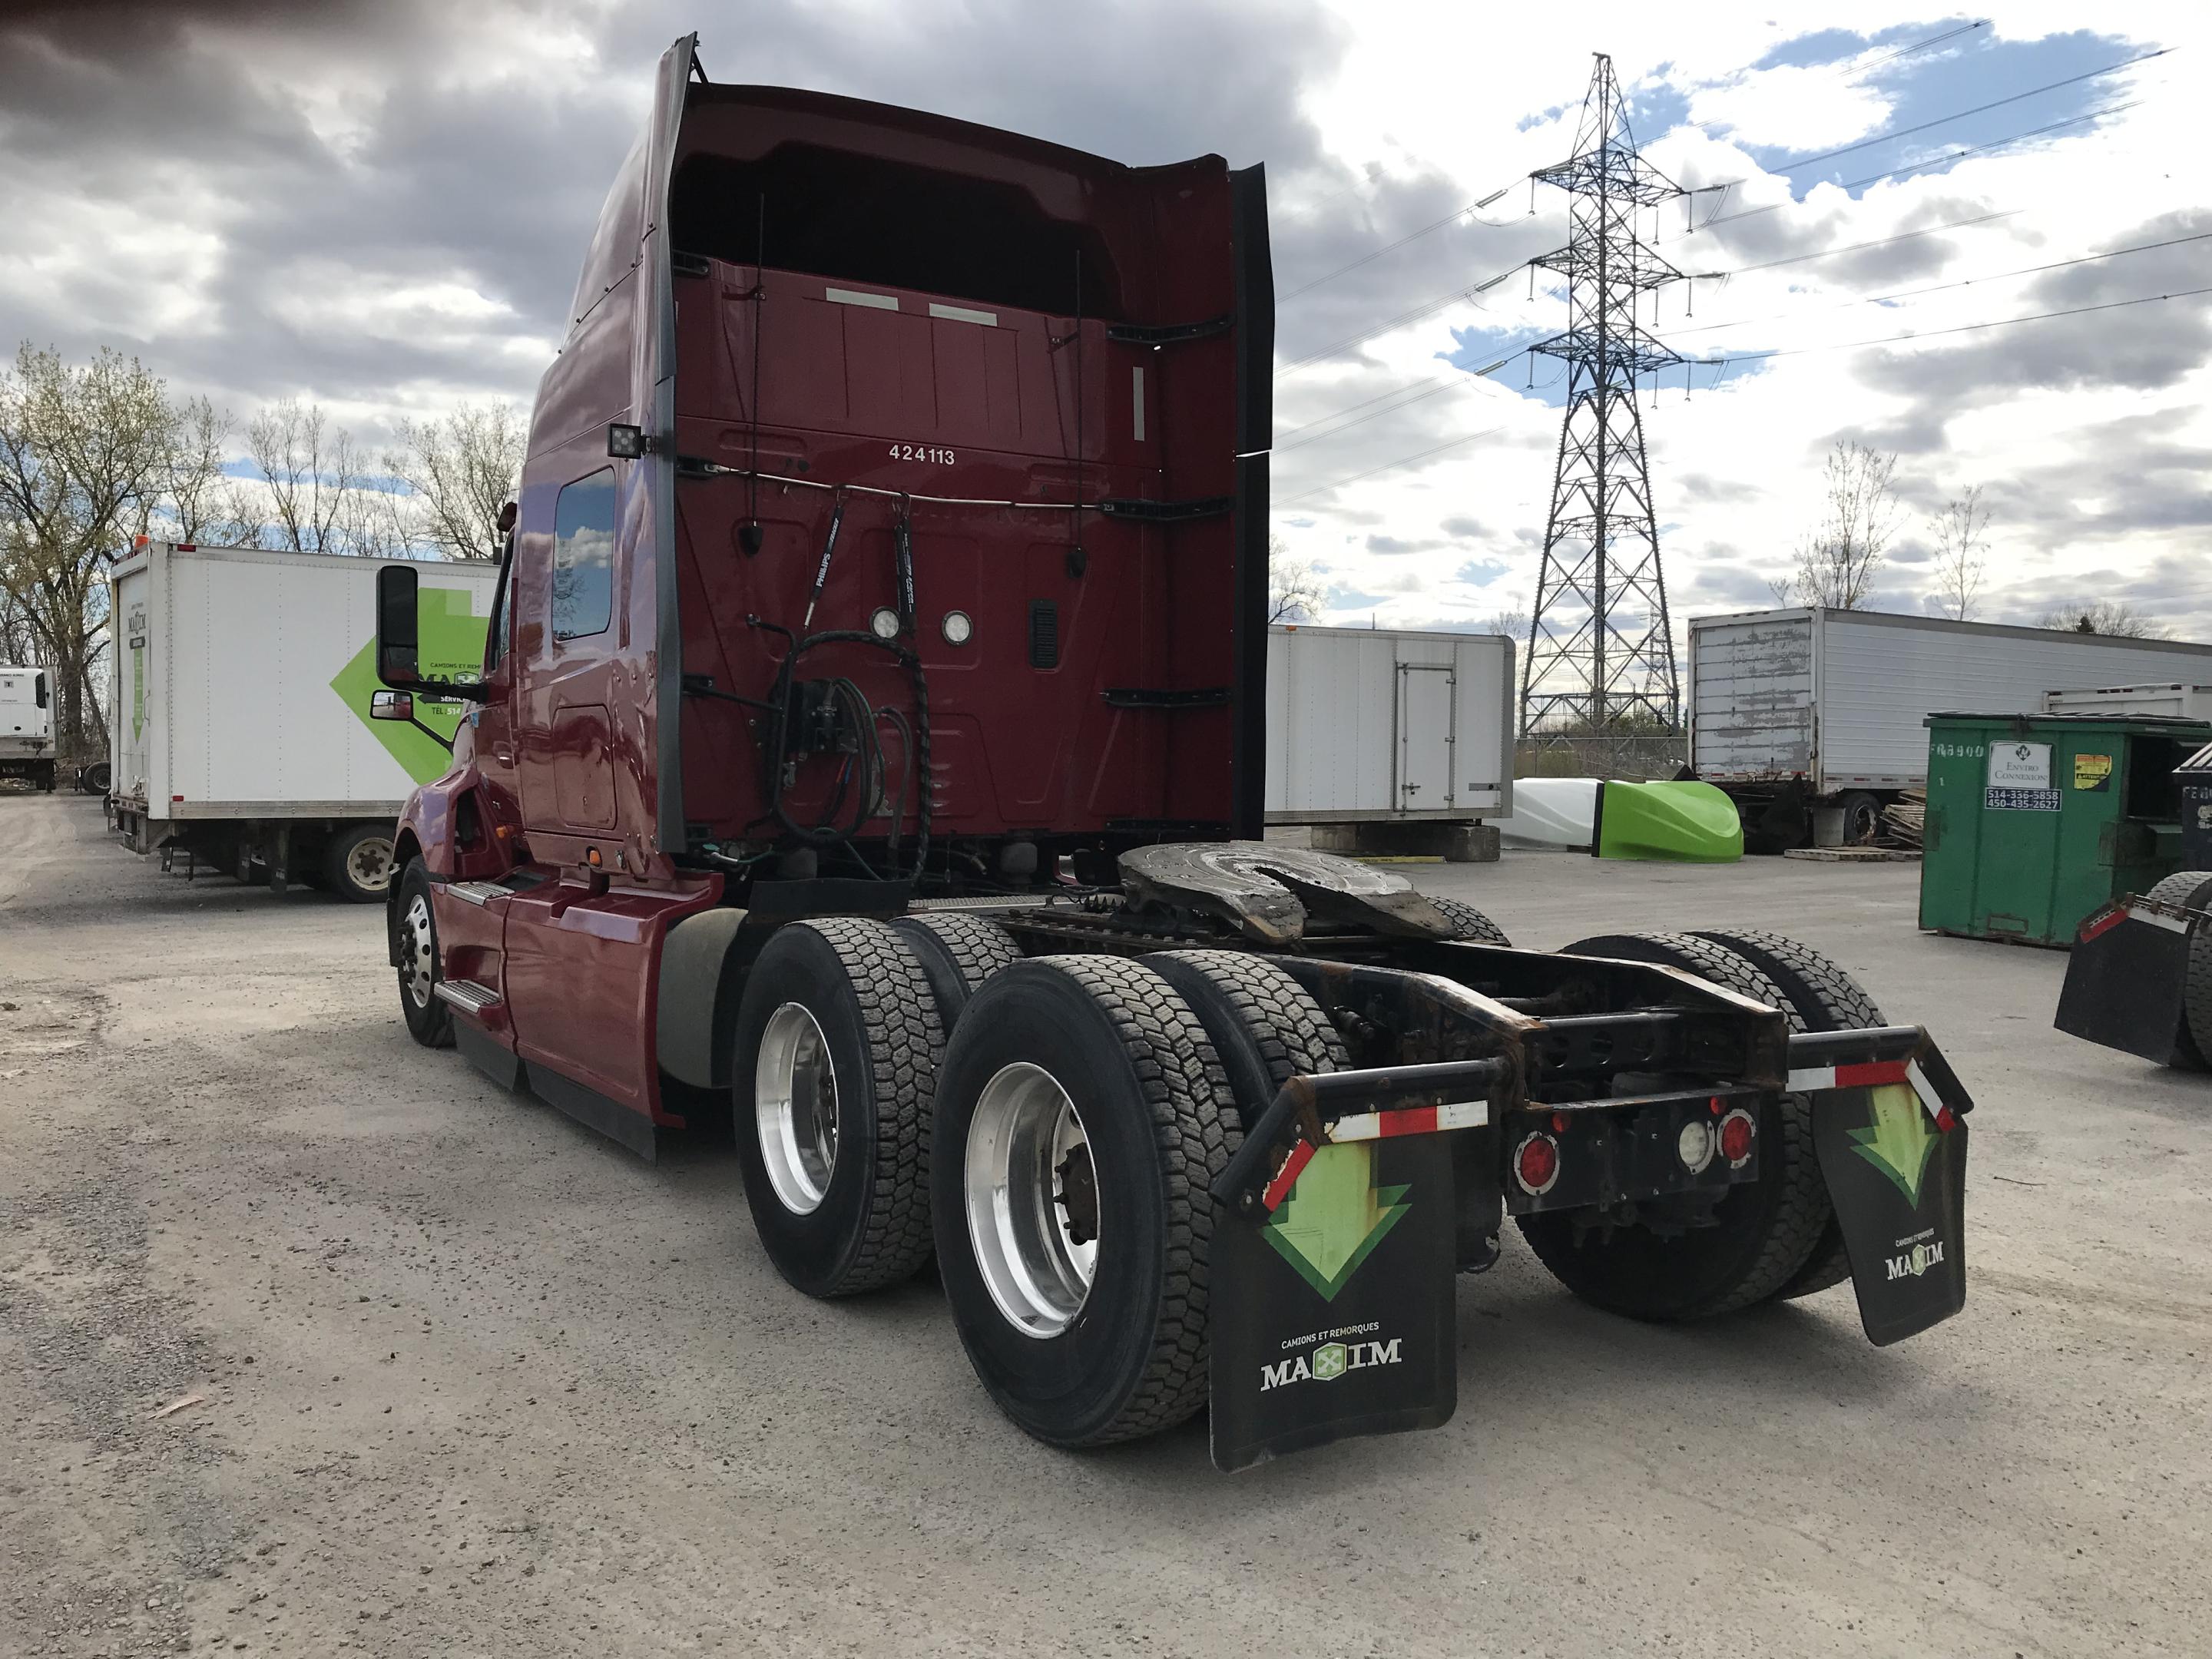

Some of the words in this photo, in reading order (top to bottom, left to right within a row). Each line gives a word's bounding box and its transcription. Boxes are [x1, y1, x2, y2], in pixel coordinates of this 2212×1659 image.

[889, 445, 955, 465] 424113
[816, 553, 831, 588] PHILLIPS
[1988, 790, 2058, 800] 514-336-5858
[1988, 799, 2058, 810] 450-435-2627
[1885, 1241, 1945, 1281] MAXIM
[1281, 1333, 1316, 1349] CAMIONS
[1318, 1330, 1329, 1341] ET
[1330, 1321, 1379, 1339] REMORQUES
[1260, 1338, 1402, 1392] MAXIM
